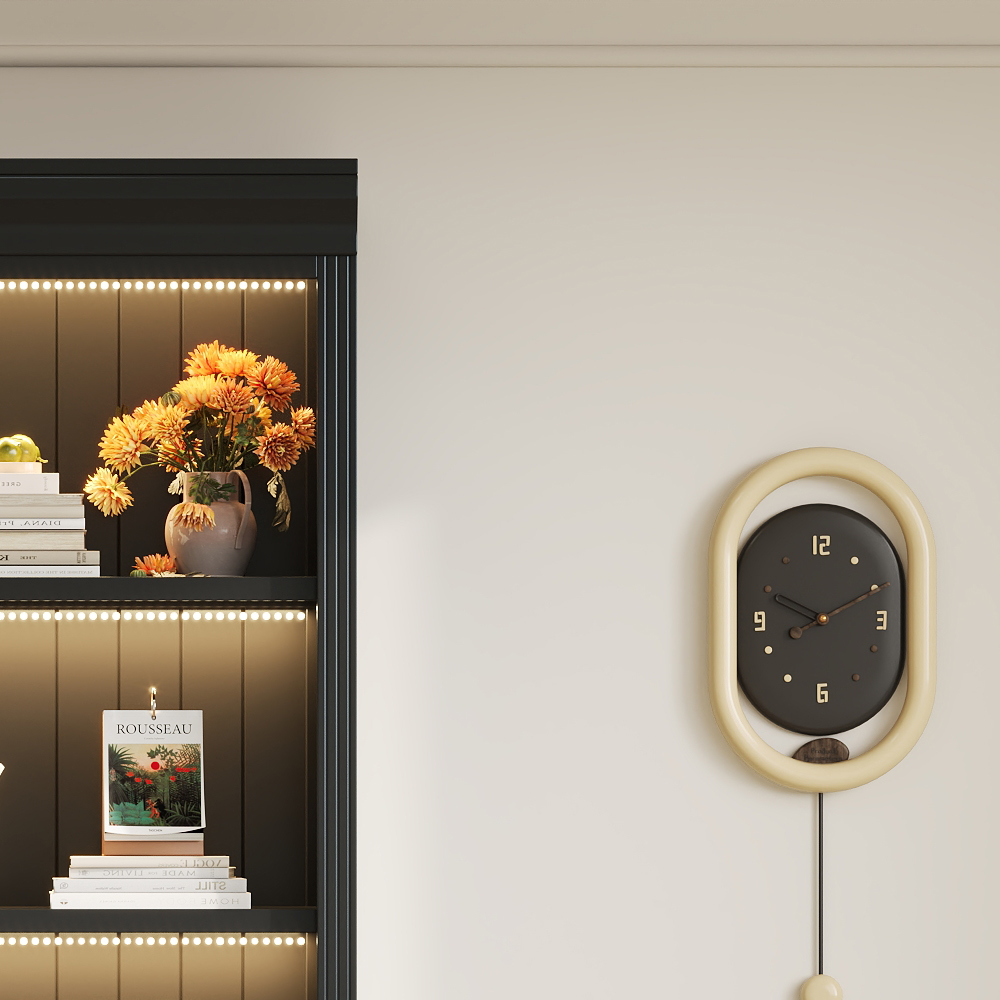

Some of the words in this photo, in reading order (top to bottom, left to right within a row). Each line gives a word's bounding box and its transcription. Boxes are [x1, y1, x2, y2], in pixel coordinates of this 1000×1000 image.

[812, 534, 831, 556] 12
[753, 610, 766, 632] 9
[876, 610, 888, 631] 3
[816, 682, 829, 704] 6
[116, 723, 193, 735] ROUSSEAU
